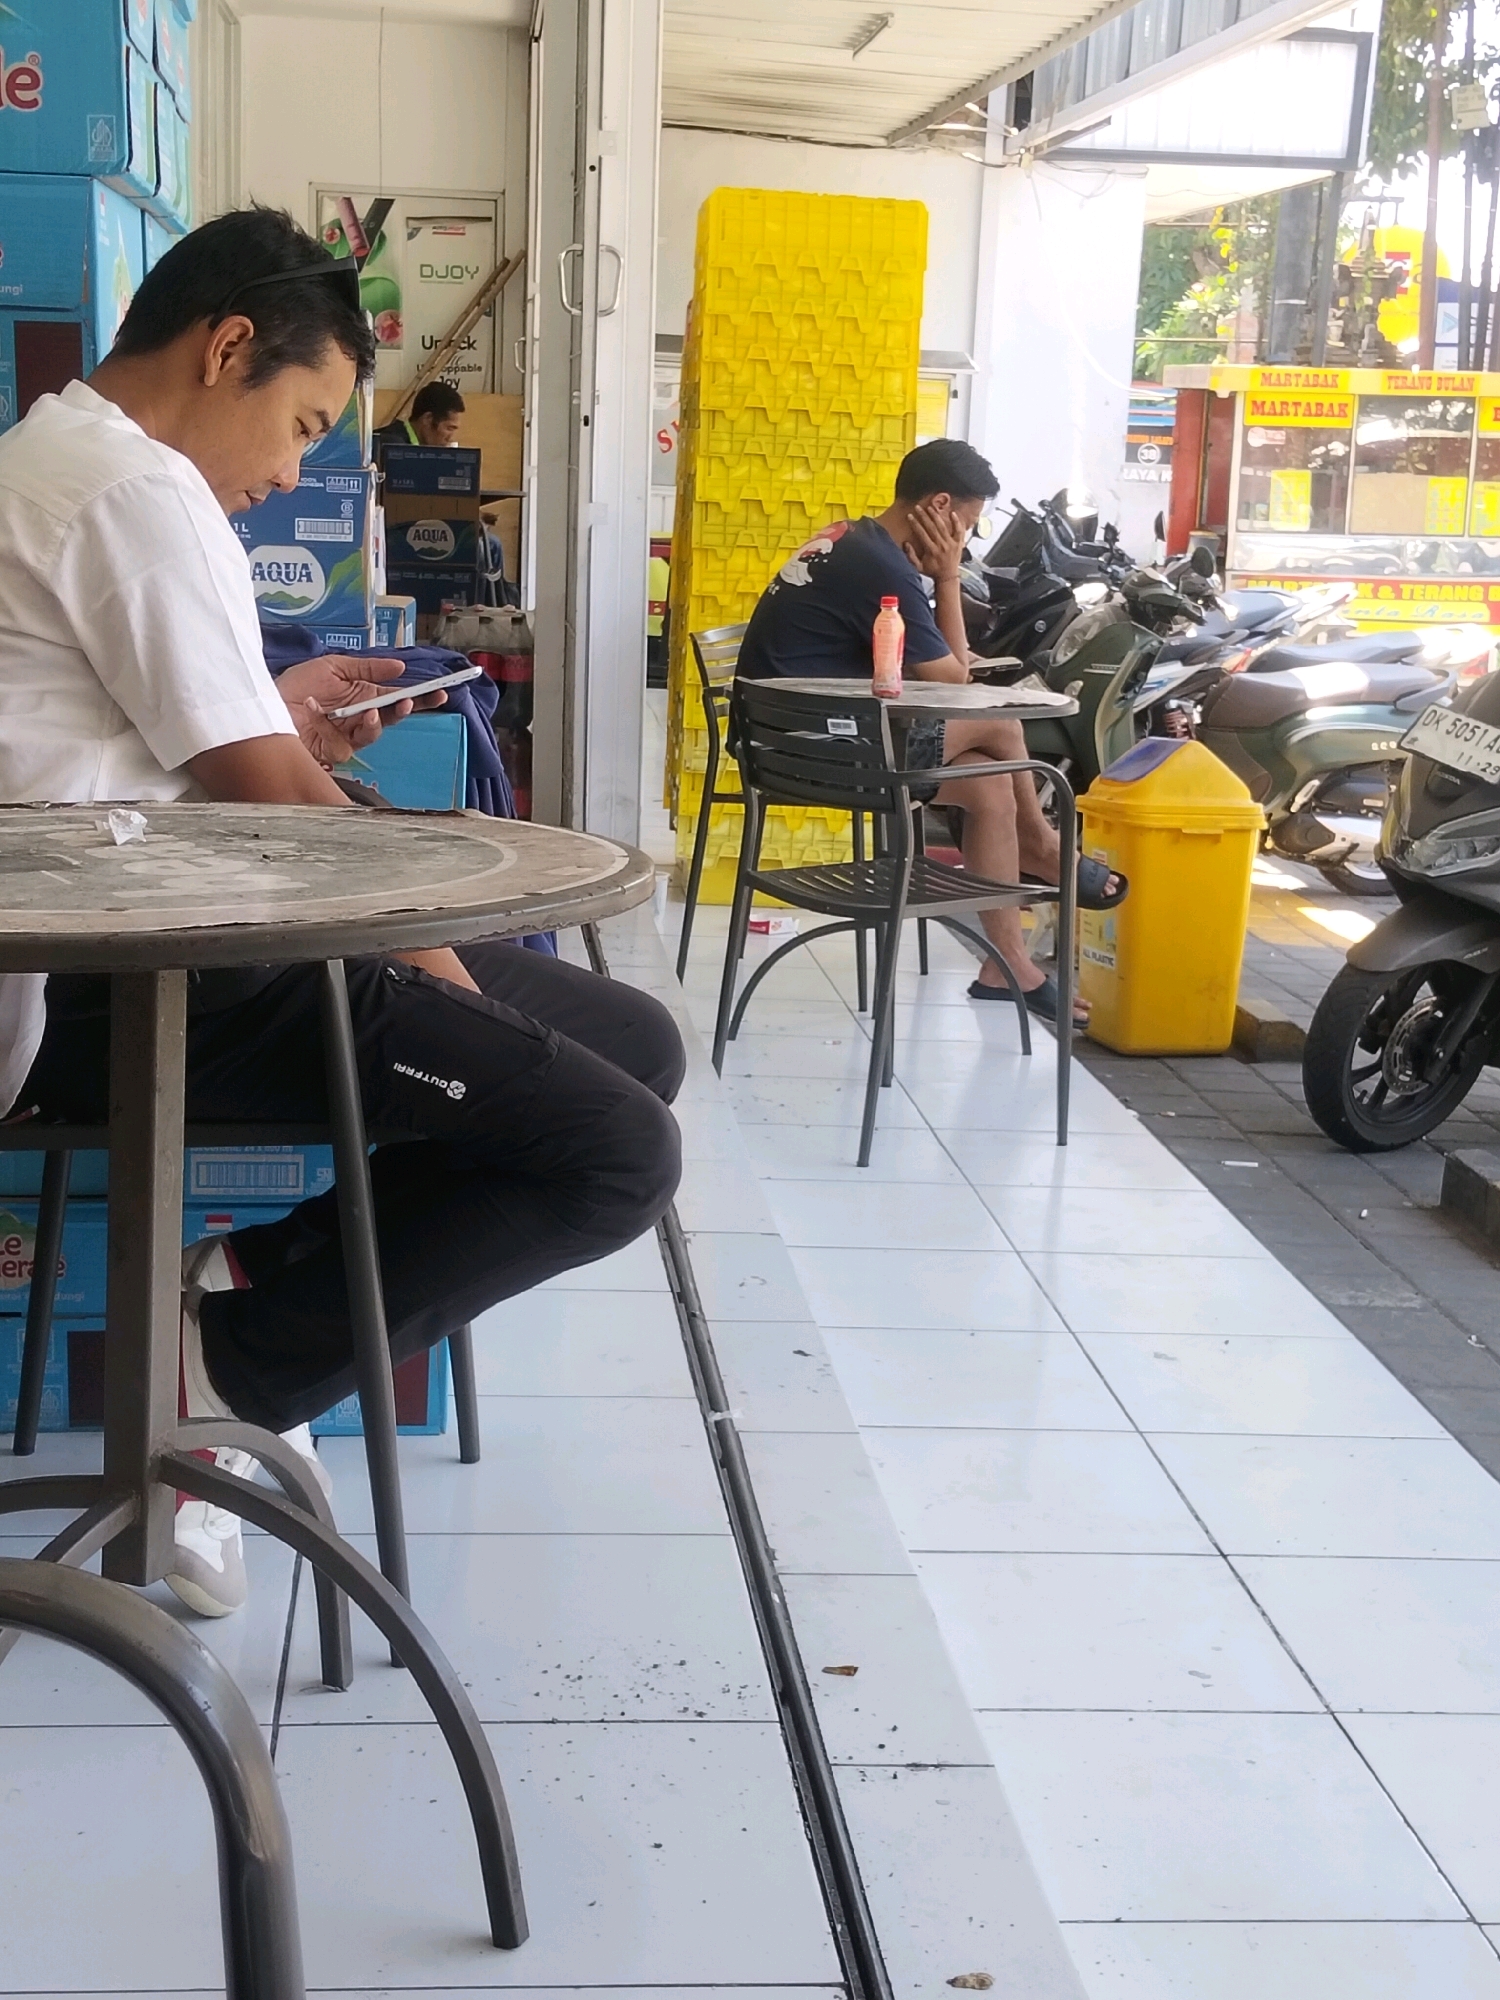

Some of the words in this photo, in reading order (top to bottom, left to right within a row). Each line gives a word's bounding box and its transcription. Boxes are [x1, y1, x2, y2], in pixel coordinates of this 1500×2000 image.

[420, 264, 479, 280] DJOY
[1260, 373, 1339, 388] MARTABAK
[1387, 375, 1432, 390] TERANG
[1437, 377, 1475, 391] BULAN
[1251, 400, 1349, 418] MARTABAK
[413, 529, 448, 543] AQUA
[251, 562, 314, 586] AQUA
[1378, 585, 1395, 599] &
[1400, 584, 1484, 601] TERANG
[1422, 709, 1449, 731] DK
[1445, 717, 1489, 747] 5051
[393, 1062, 448, 1089] OUTFRAI
